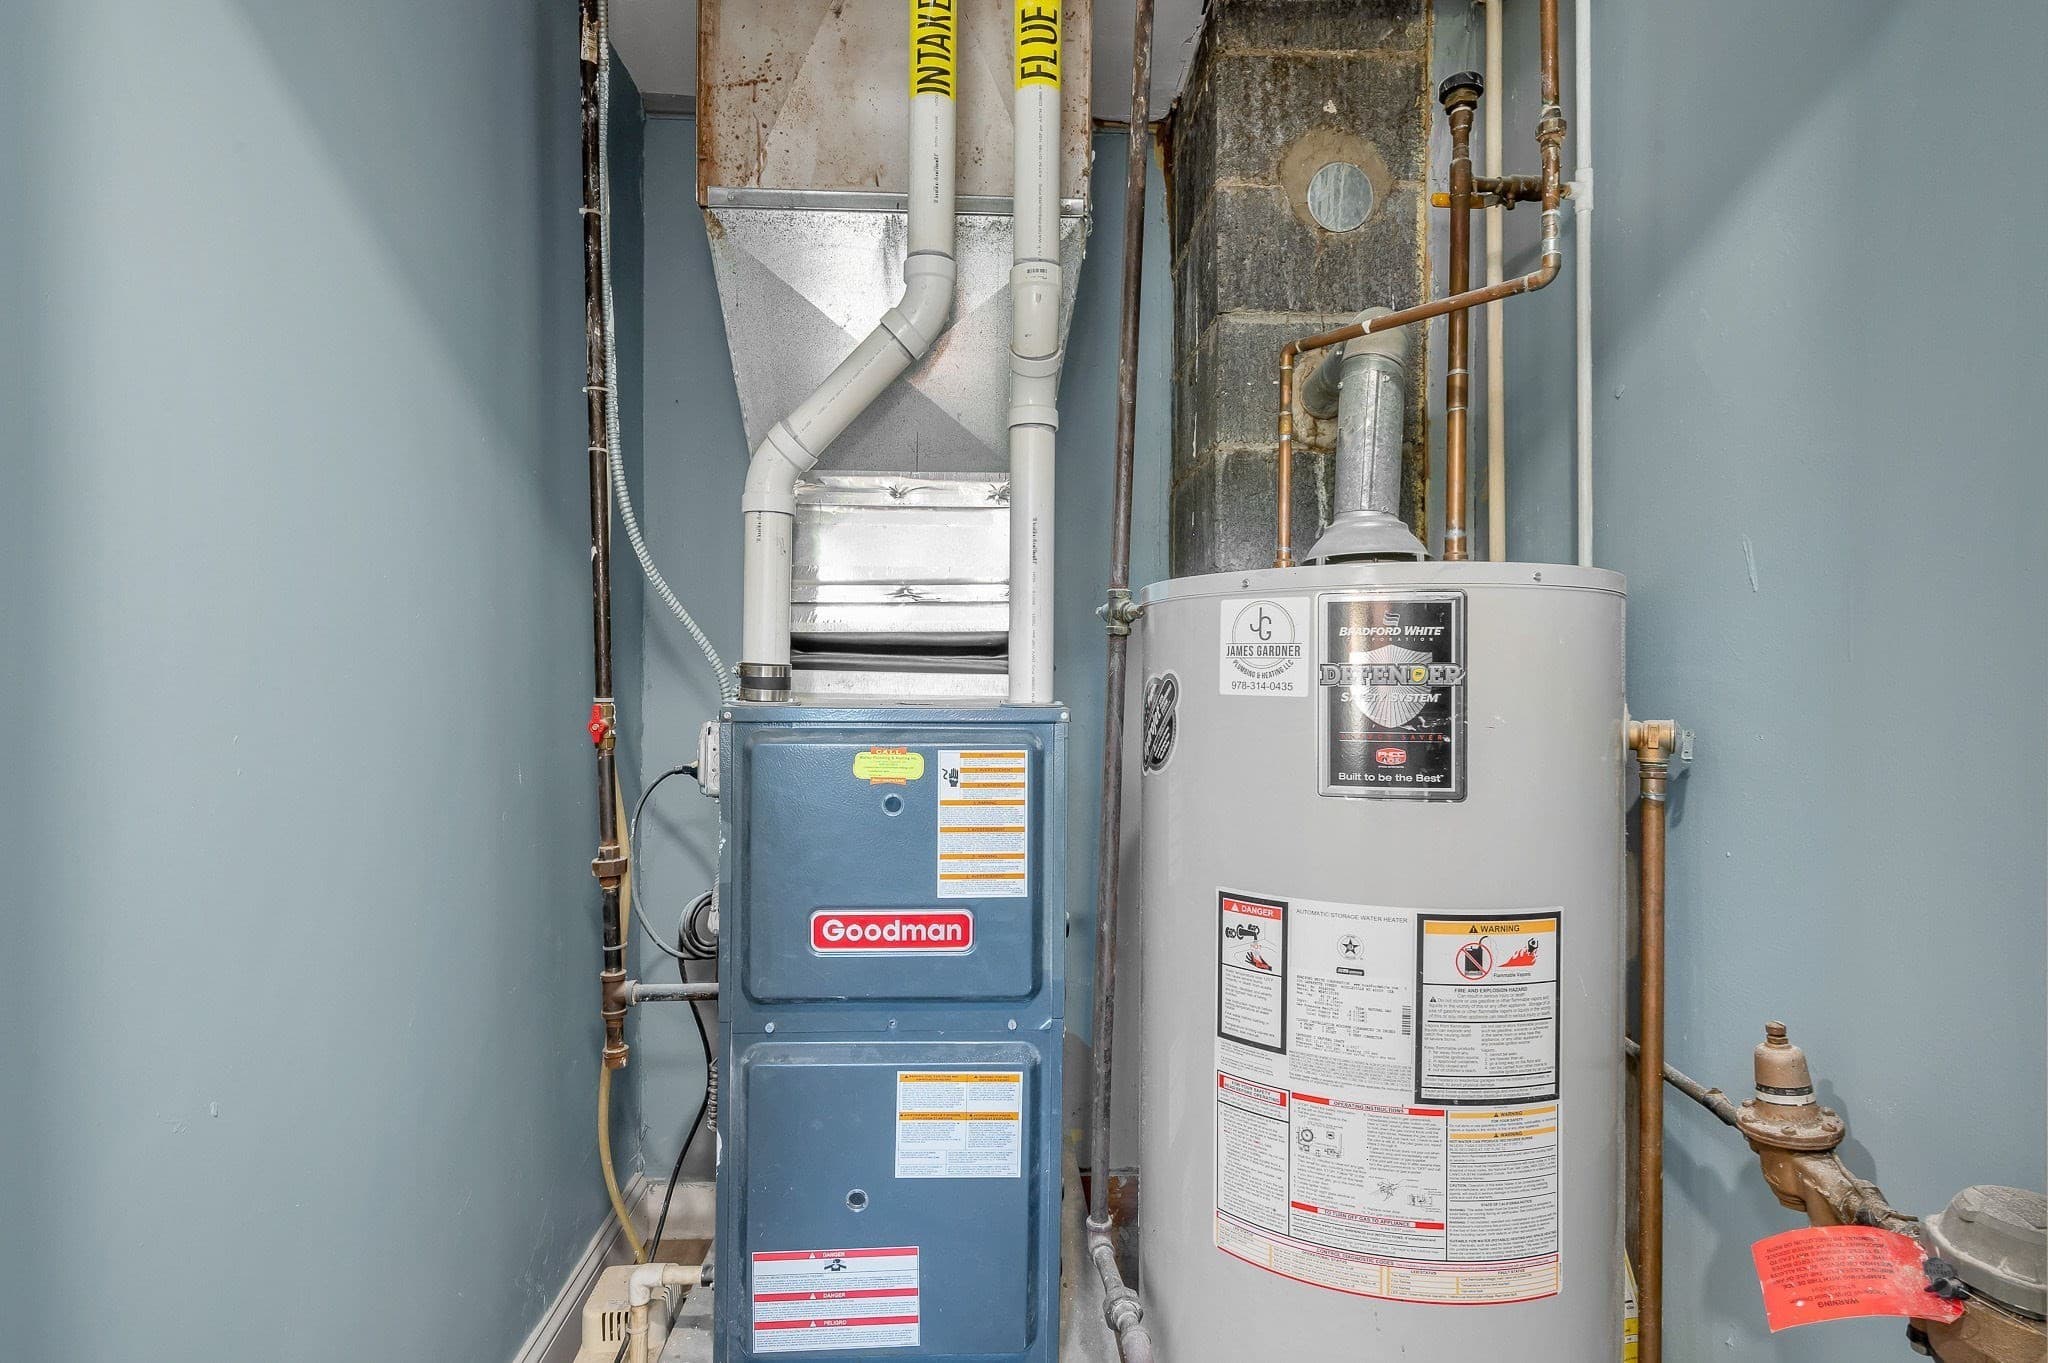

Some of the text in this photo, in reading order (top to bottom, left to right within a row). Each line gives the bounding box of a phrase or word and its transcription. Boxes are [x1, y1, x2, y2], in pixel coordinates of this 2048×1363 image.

[916, 0, 951, 97] INTAKE
[1020, 7, 1058, 82] FLUE
[1404, 625, 1443, 636] WHITE
[1226, 645, 1301, 657] JAMES GARDNER
[1232, 659, 1256, 678] PLUMBING
[1261, 667, 1284, 679] HEATING
[1283, 659, 1294, 670] LLC
[1320, 663, 1464, 687] DEFENDER
[1231, 681, 1294, 691] 978-314-0435
[1338, 772, 1442, 783] Built to be the Best
[1241, 905, 1274, 918] DANGER
[1296, 909, 1329, 918] AUTOMATIC
[1330, 912, 1360, 920] STORAGE
[822, 919, 962, 942] Goodman
[1480, 925, 1520, 933] WARNING
[1818, 1297, 1860, 1308] WARNING
